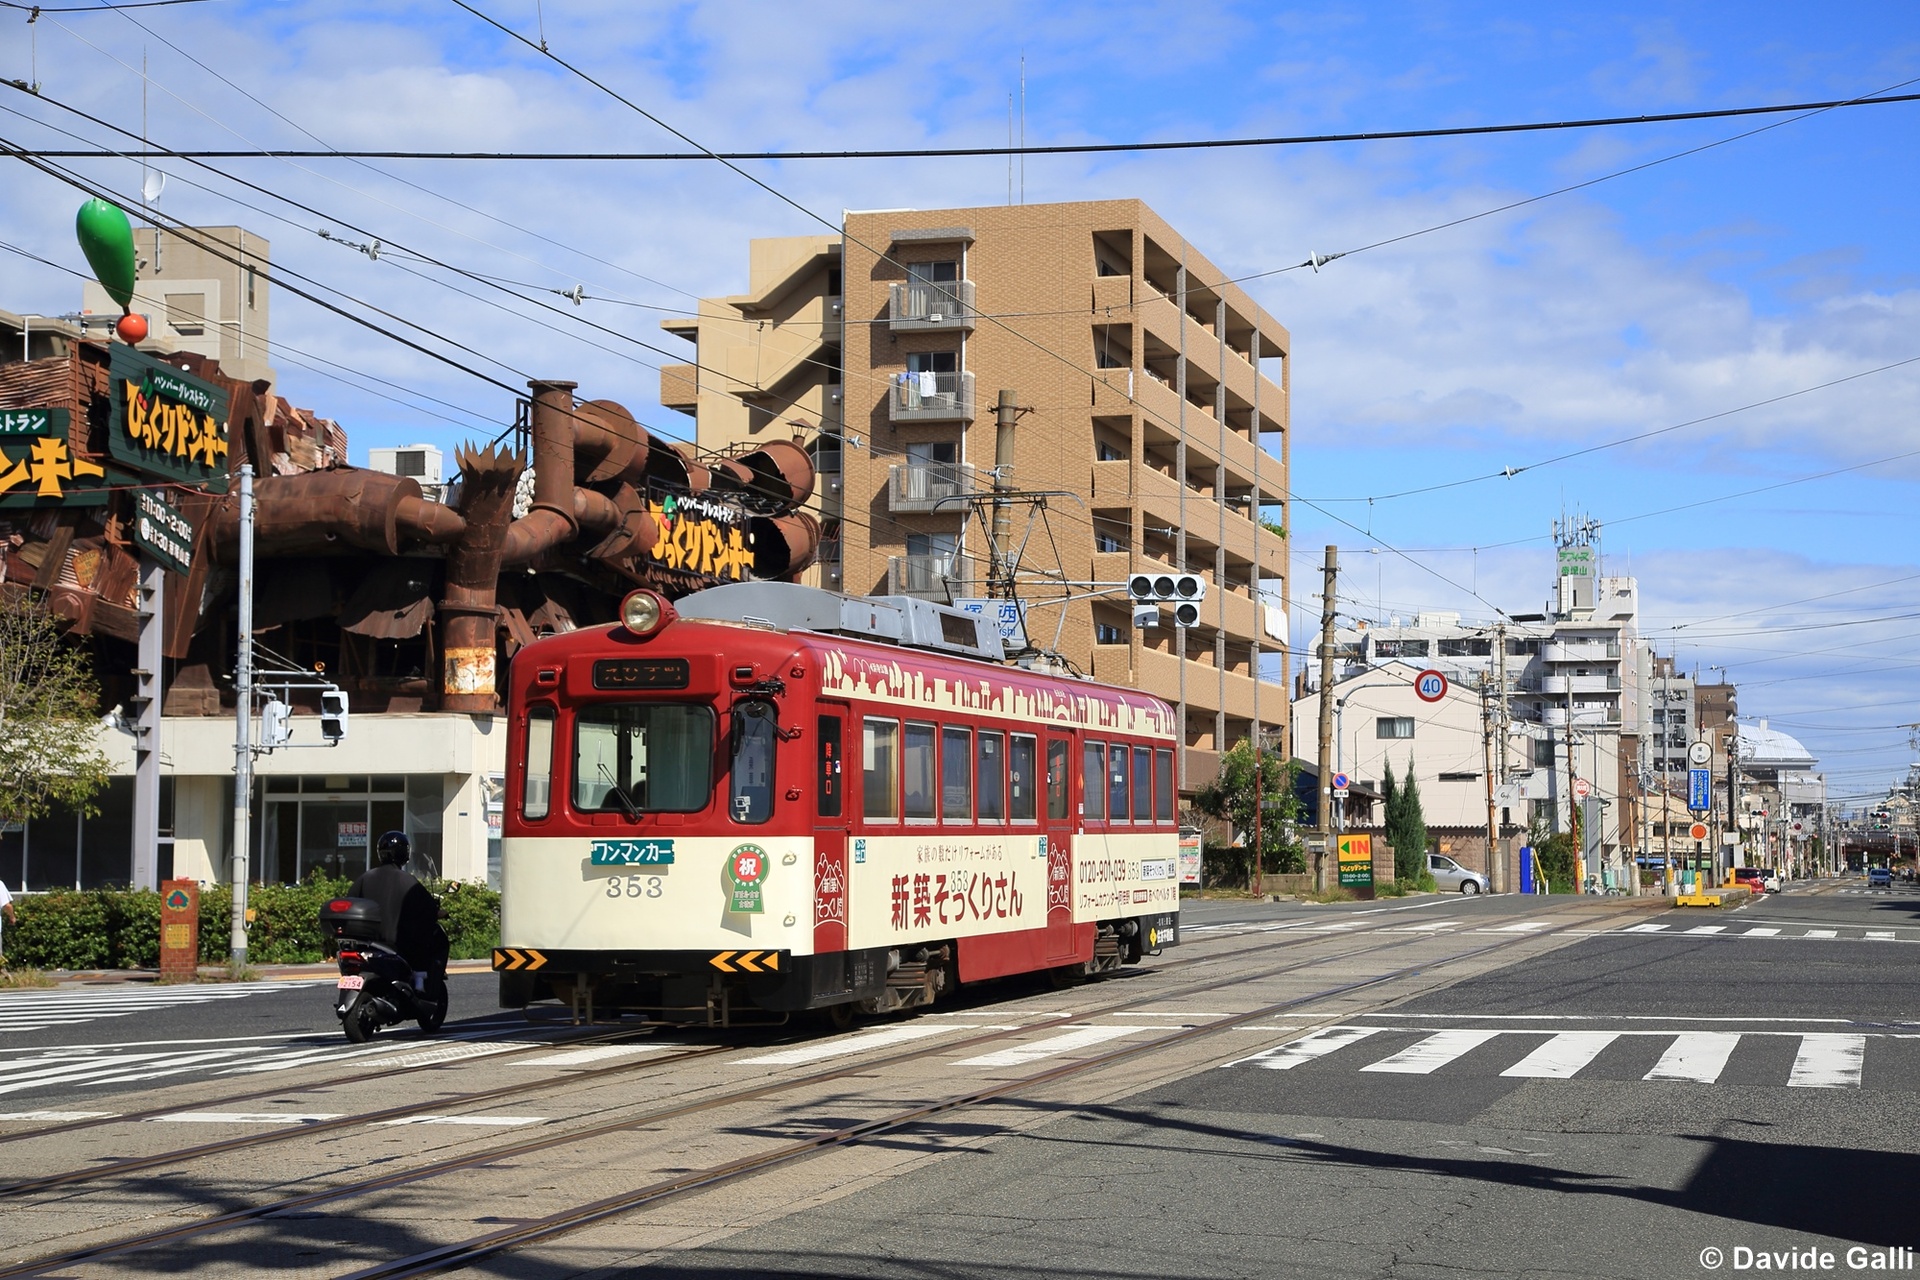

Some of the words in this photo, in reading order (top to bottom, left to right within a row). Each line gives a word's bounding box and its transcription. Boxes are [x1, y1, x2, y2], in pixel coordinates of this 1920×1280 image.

[154, 376, 209, 407] ハンバーグレストラン
[0, 413, 46, 432] トラン
[1422, 678, 1440, 693] 40
[593, 842, 671, 861] ワンマンカー
[1351, 840, 1369, 855] IN
[739, 858, 757, 876] 祝
[1080, 859, 1126, 883] 0120-901-039
[1127, 862, 1140, 880] 353
[606, 876, 663, 898] 353
[950, 870, 969, 893] 353
[891, 871, 1023, 931] 新築そっくりさん
